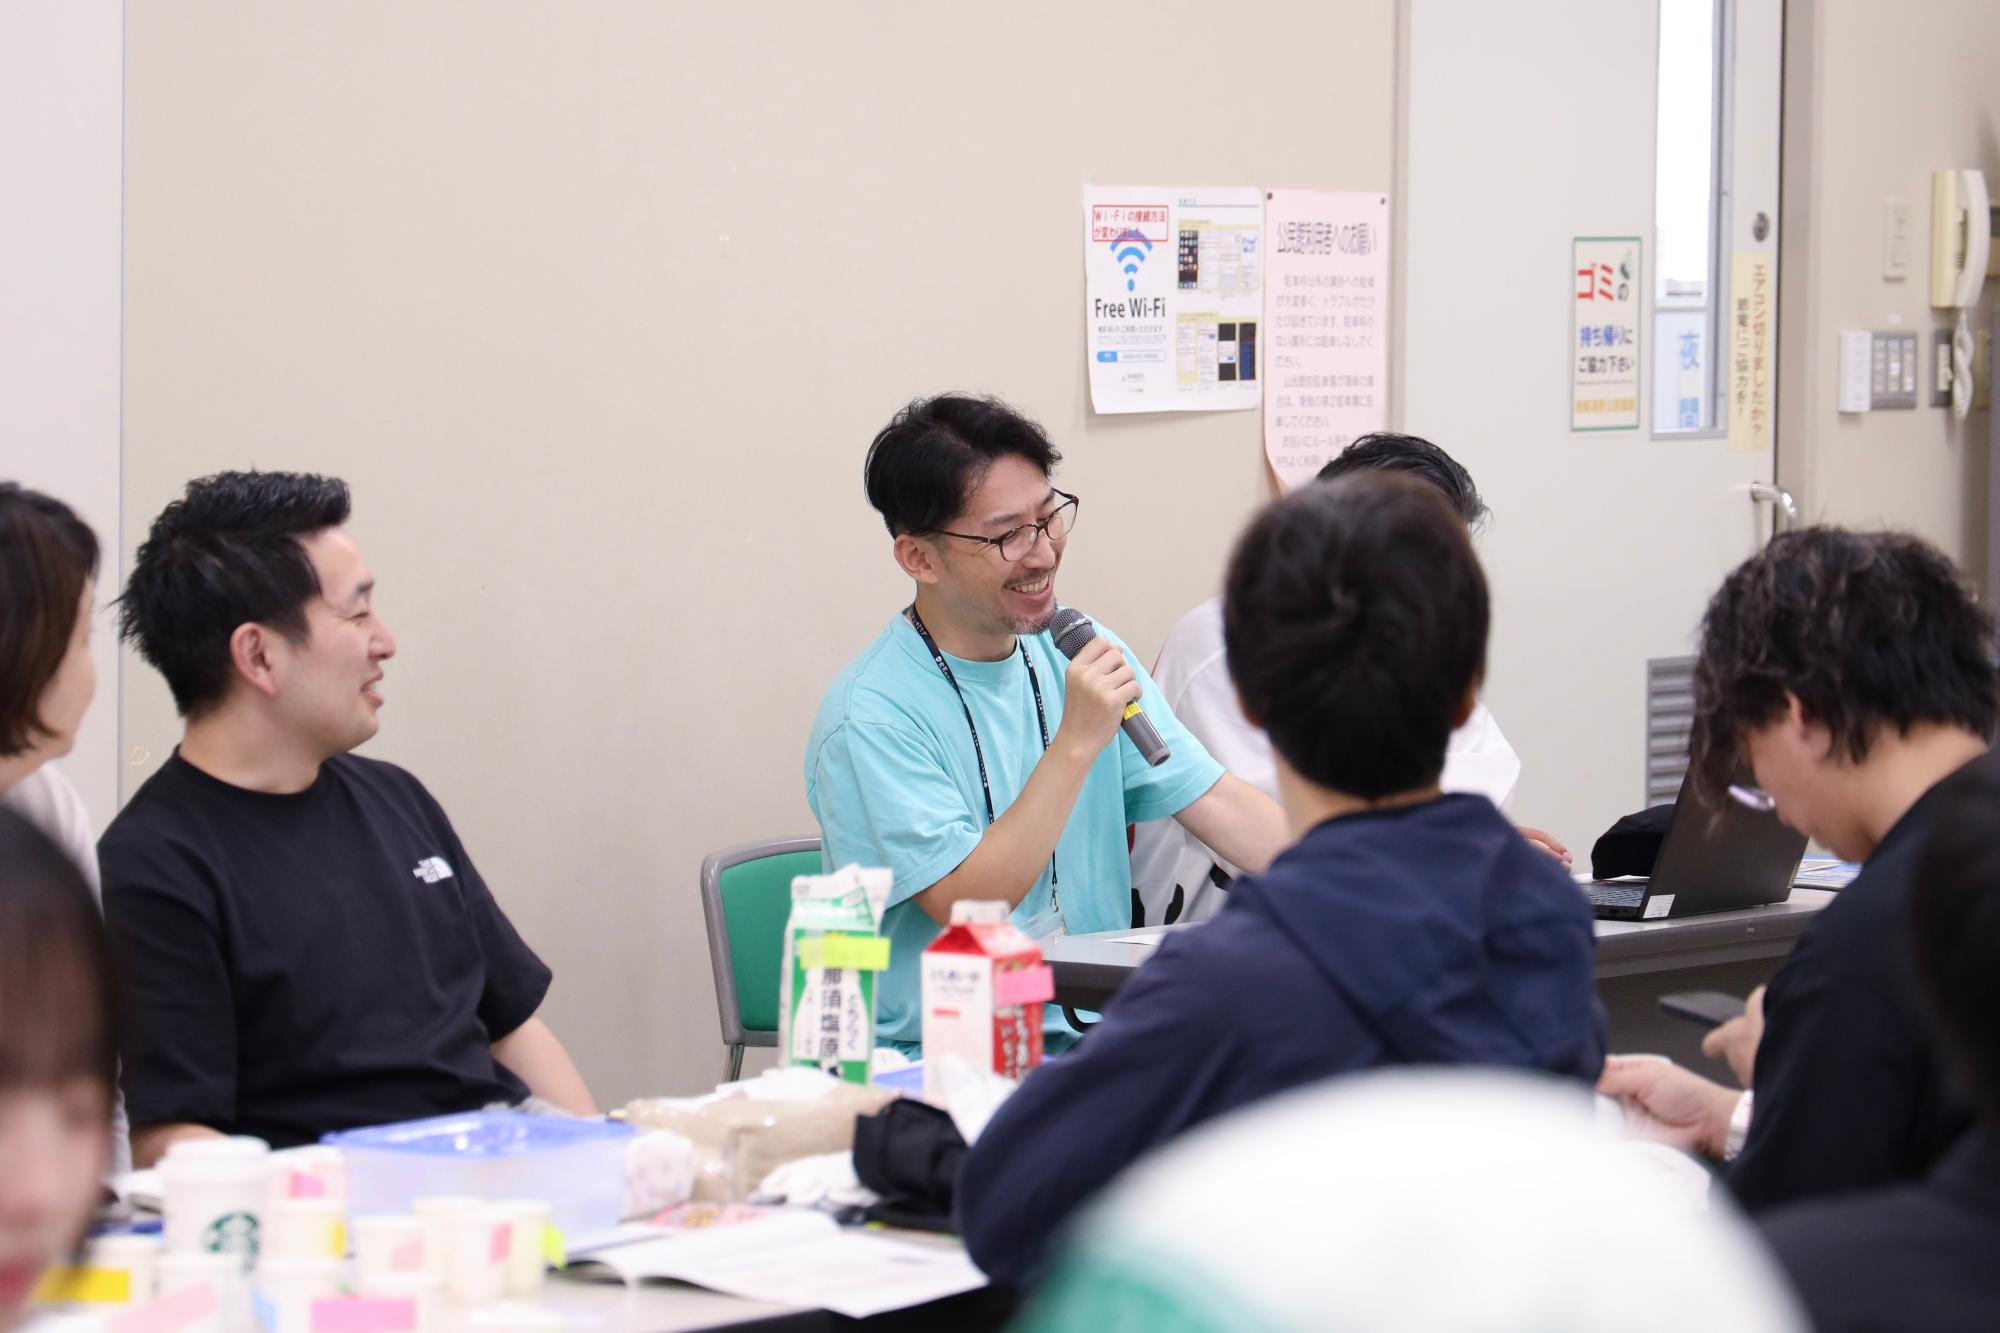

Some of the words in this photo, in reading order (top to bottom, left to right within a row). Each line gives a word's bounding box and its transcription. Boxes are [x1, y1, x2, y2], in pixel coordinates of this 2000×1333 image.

[1577, 262, 1630, 301] ゴミの
[1096, 298, 1125, 318] Free
[1129, 297, 1166, 318] Wi-Fi
[1579, 325, 1634, 347] 持ち帰りに
[1578, 355, 1635, 374] ご協力下さい
